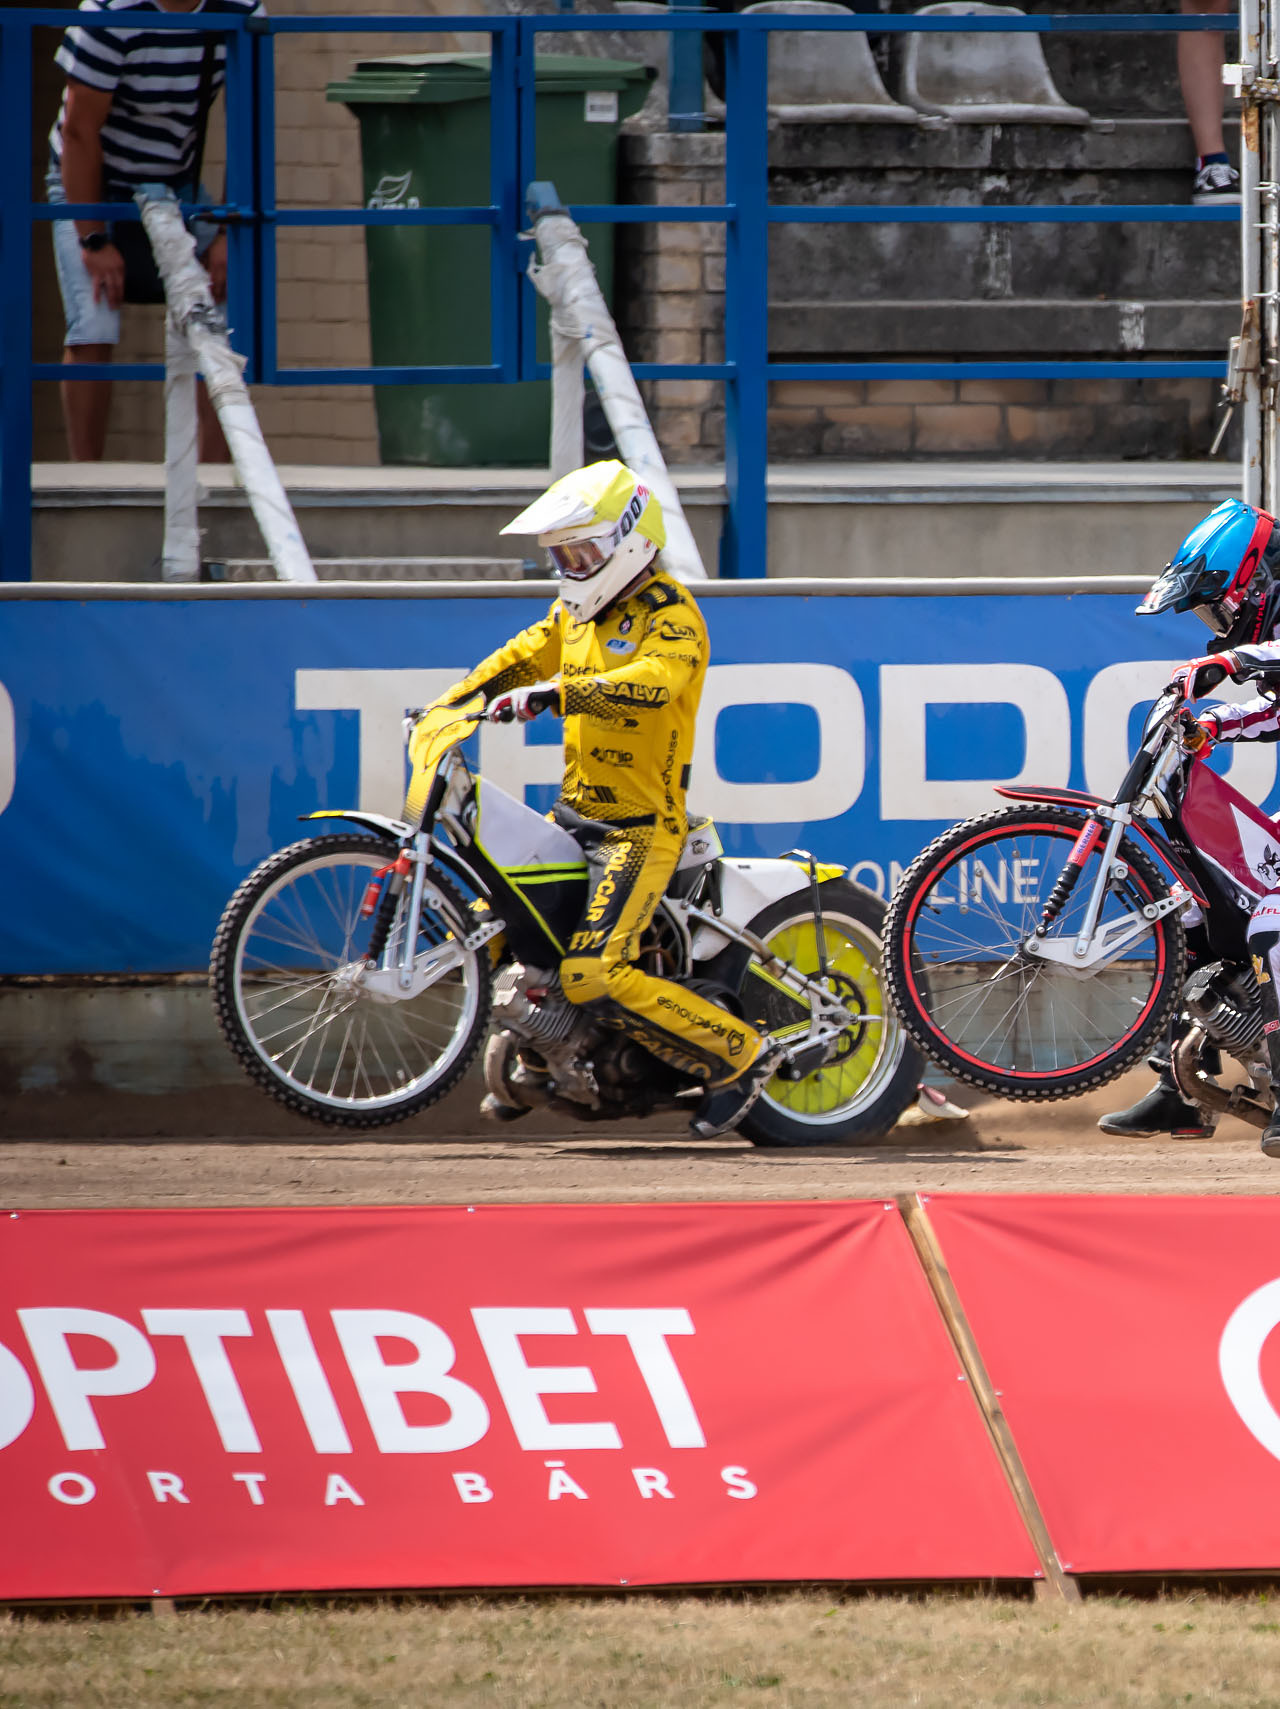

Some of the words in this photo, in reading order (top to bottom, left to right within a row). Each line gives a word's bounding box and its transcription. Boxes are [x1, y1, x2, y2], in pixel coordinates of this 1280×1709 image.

[600, 682, 669, 703] SALVA
[1077, 823, 1097, 855] BERNER
[585, 841, 633, 922] POL-CAR
[657, 995, 727, 1038] spechouse
[0, 1307, 706, 1454] PTIBET
[452, 1460, 758, 1504] BĀRS
